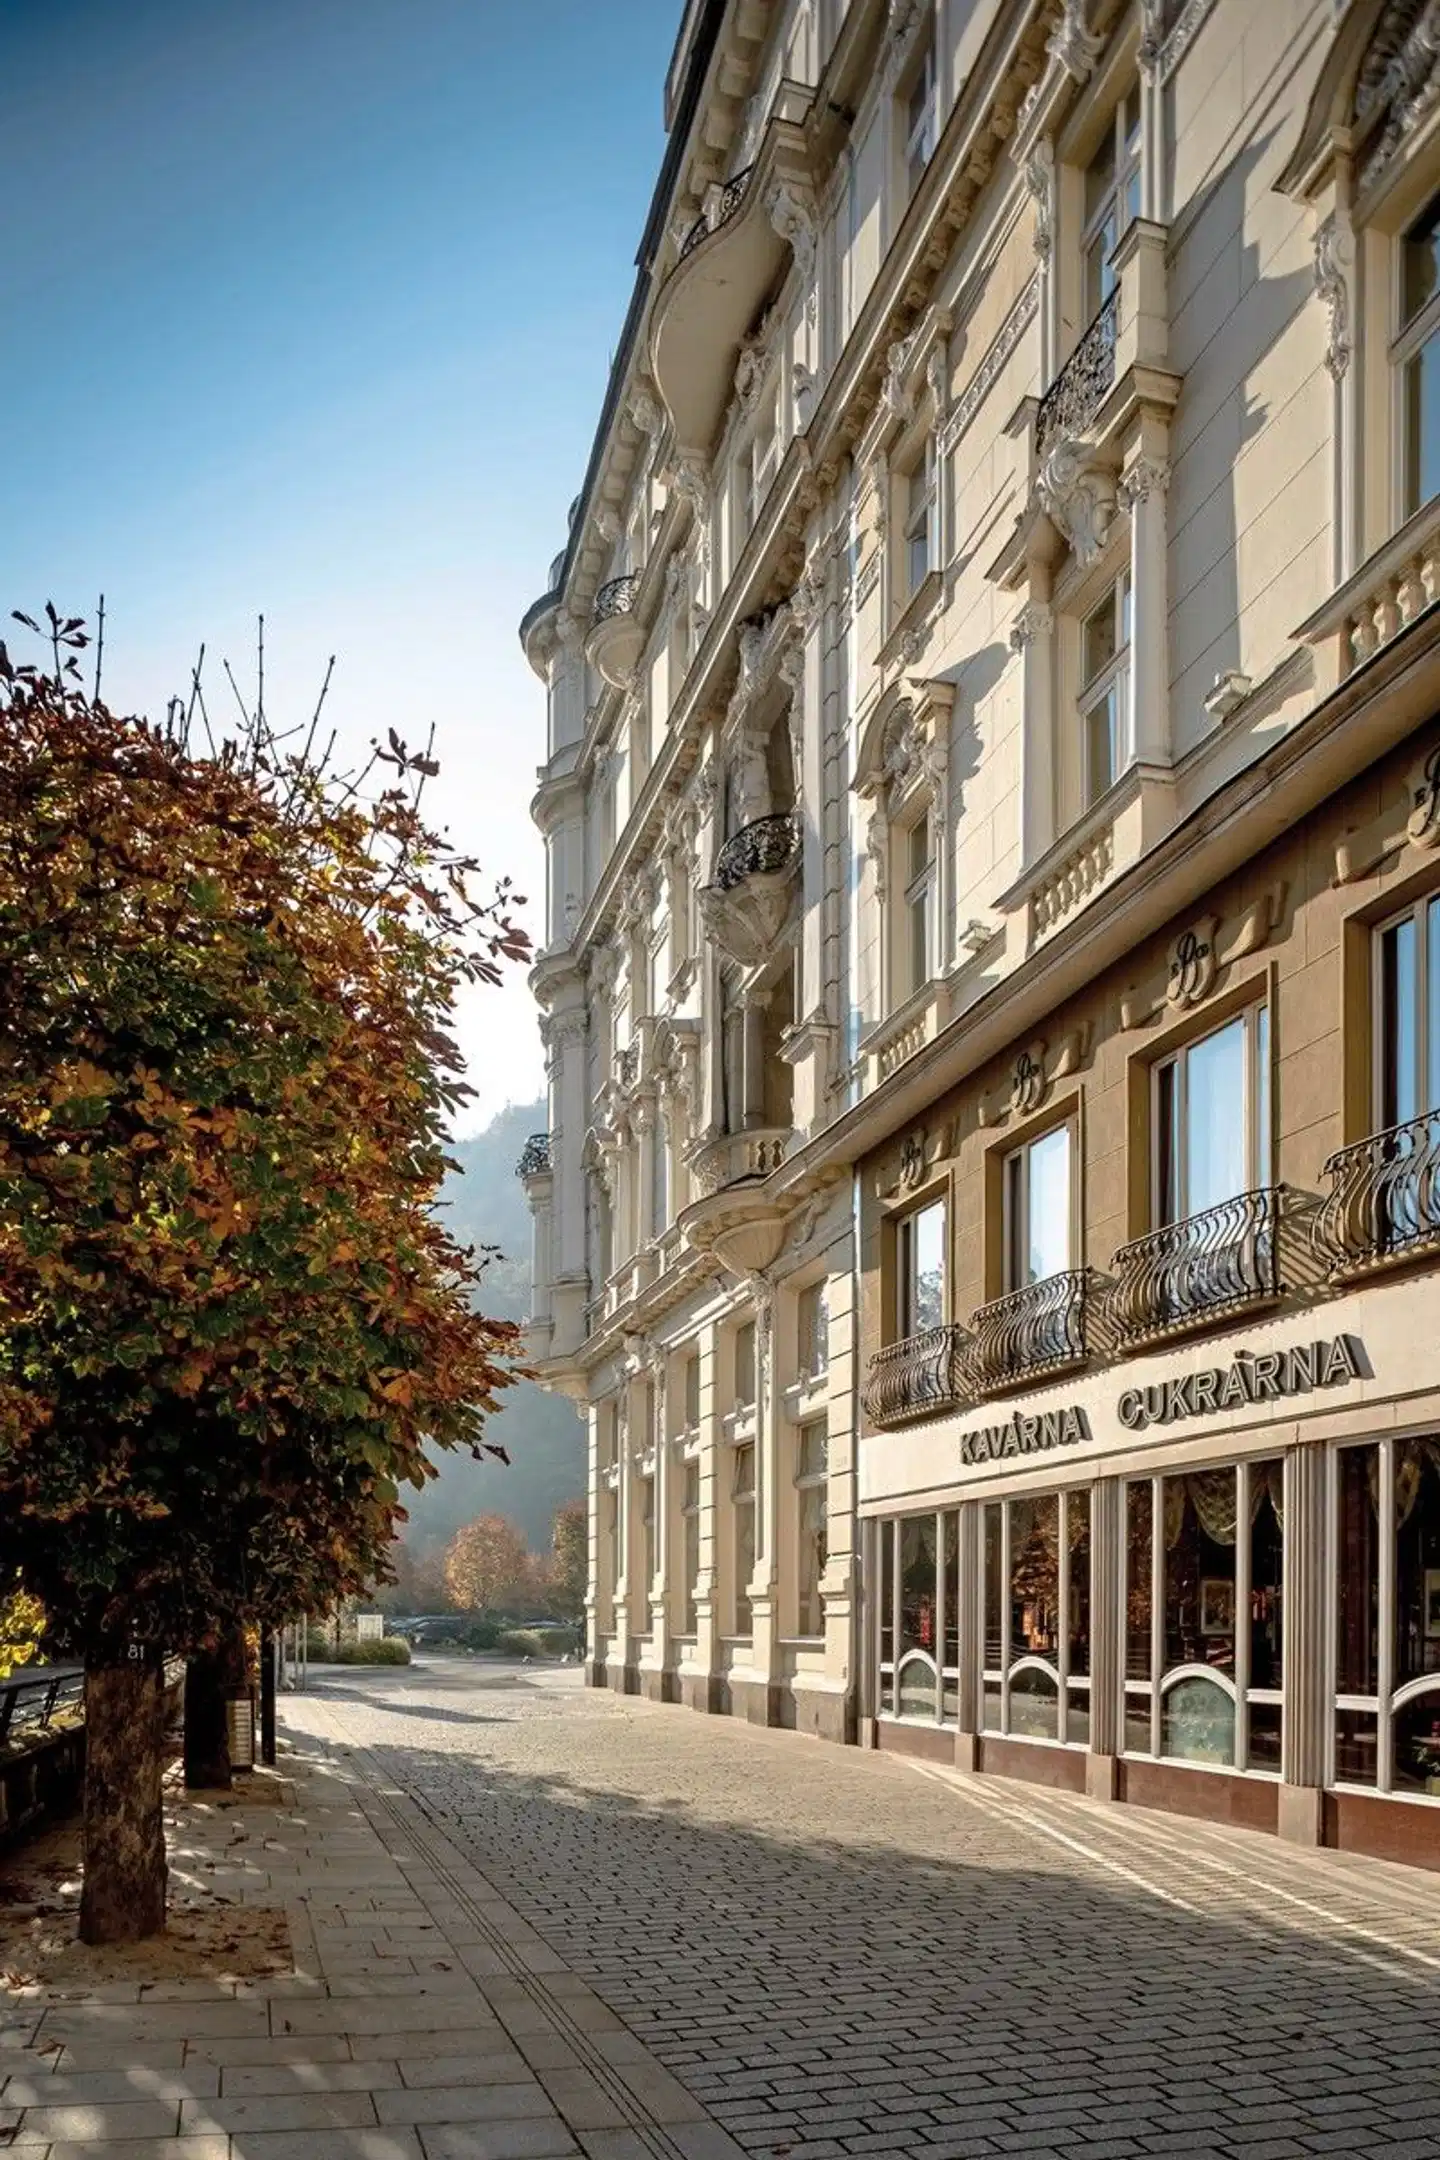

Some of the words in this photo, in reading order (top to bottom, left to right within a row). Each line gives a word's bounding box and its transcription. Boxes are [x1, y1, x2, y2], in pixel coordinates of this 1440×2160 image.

[960, 1406, 1093, 1466] KAVÁRNA
[1117, 1333, 1375, 1431] CUKRÁRNA
[128, 1644, 144, 1660] 81
